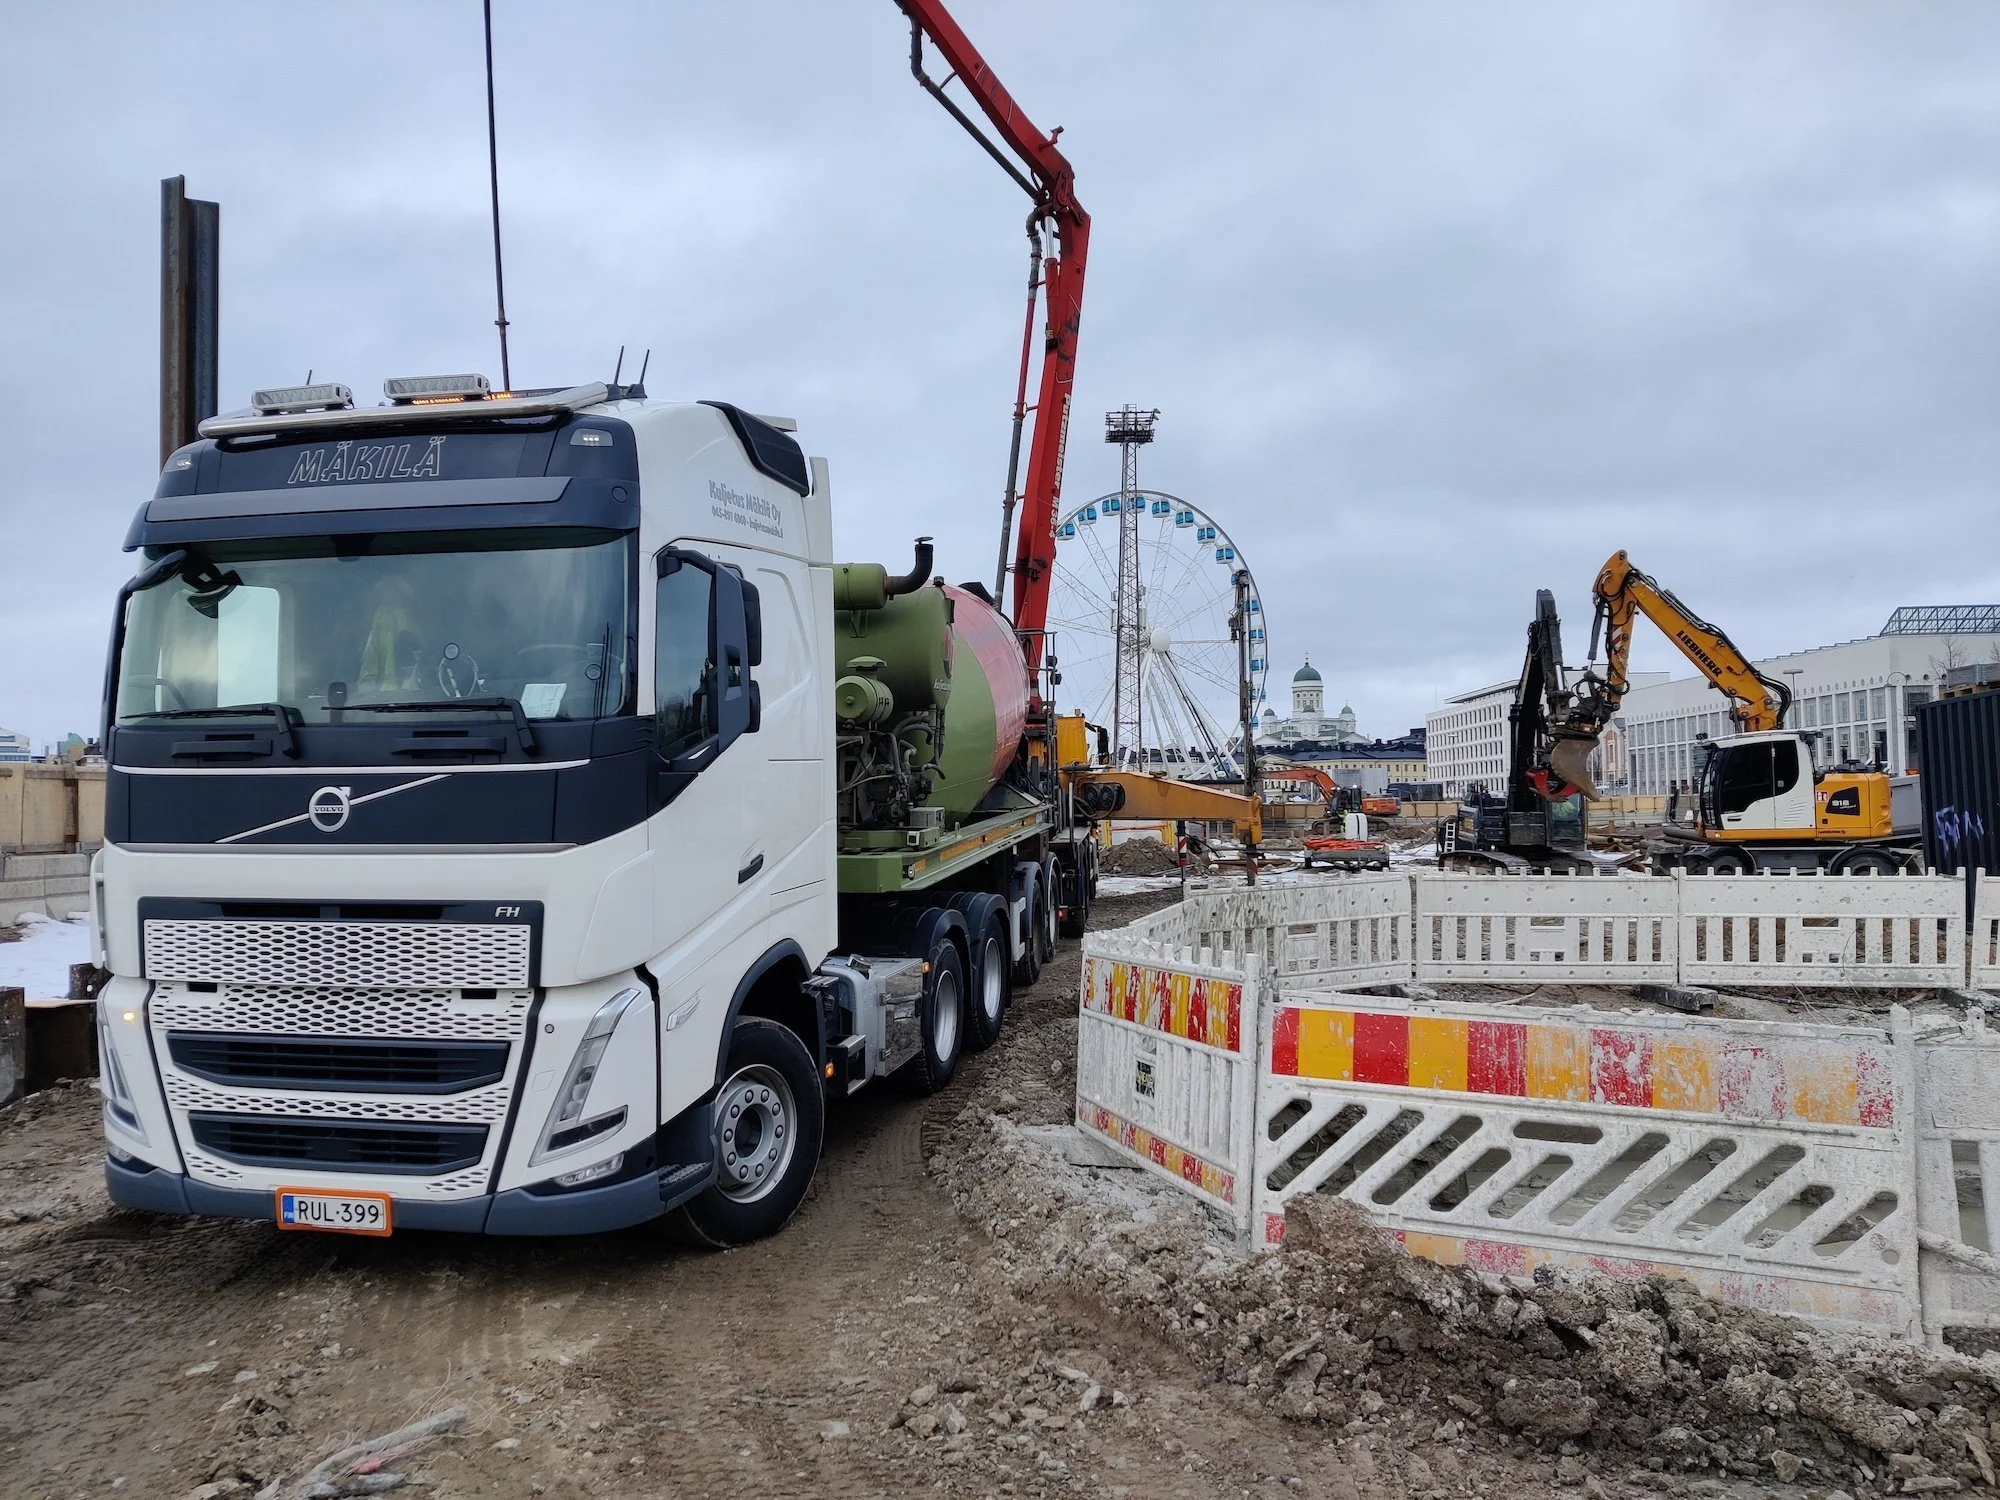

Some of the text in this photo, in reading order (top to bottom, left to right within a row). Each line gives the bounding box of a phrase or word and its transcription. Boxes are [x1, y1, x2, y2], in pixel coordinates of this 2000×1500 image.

[287, 436, 446, 484] MÄKILÄ
[1054, 393, 1071, 490] Putzmeister
[708, 480, 745, 509] Kuljetus
[771, 503, 782, 526] Oy
[1051, 496, 1060, 509] M
[1676, 630, 1723, 678] LIEBHERR
[494, 906, 521, 918] FH
